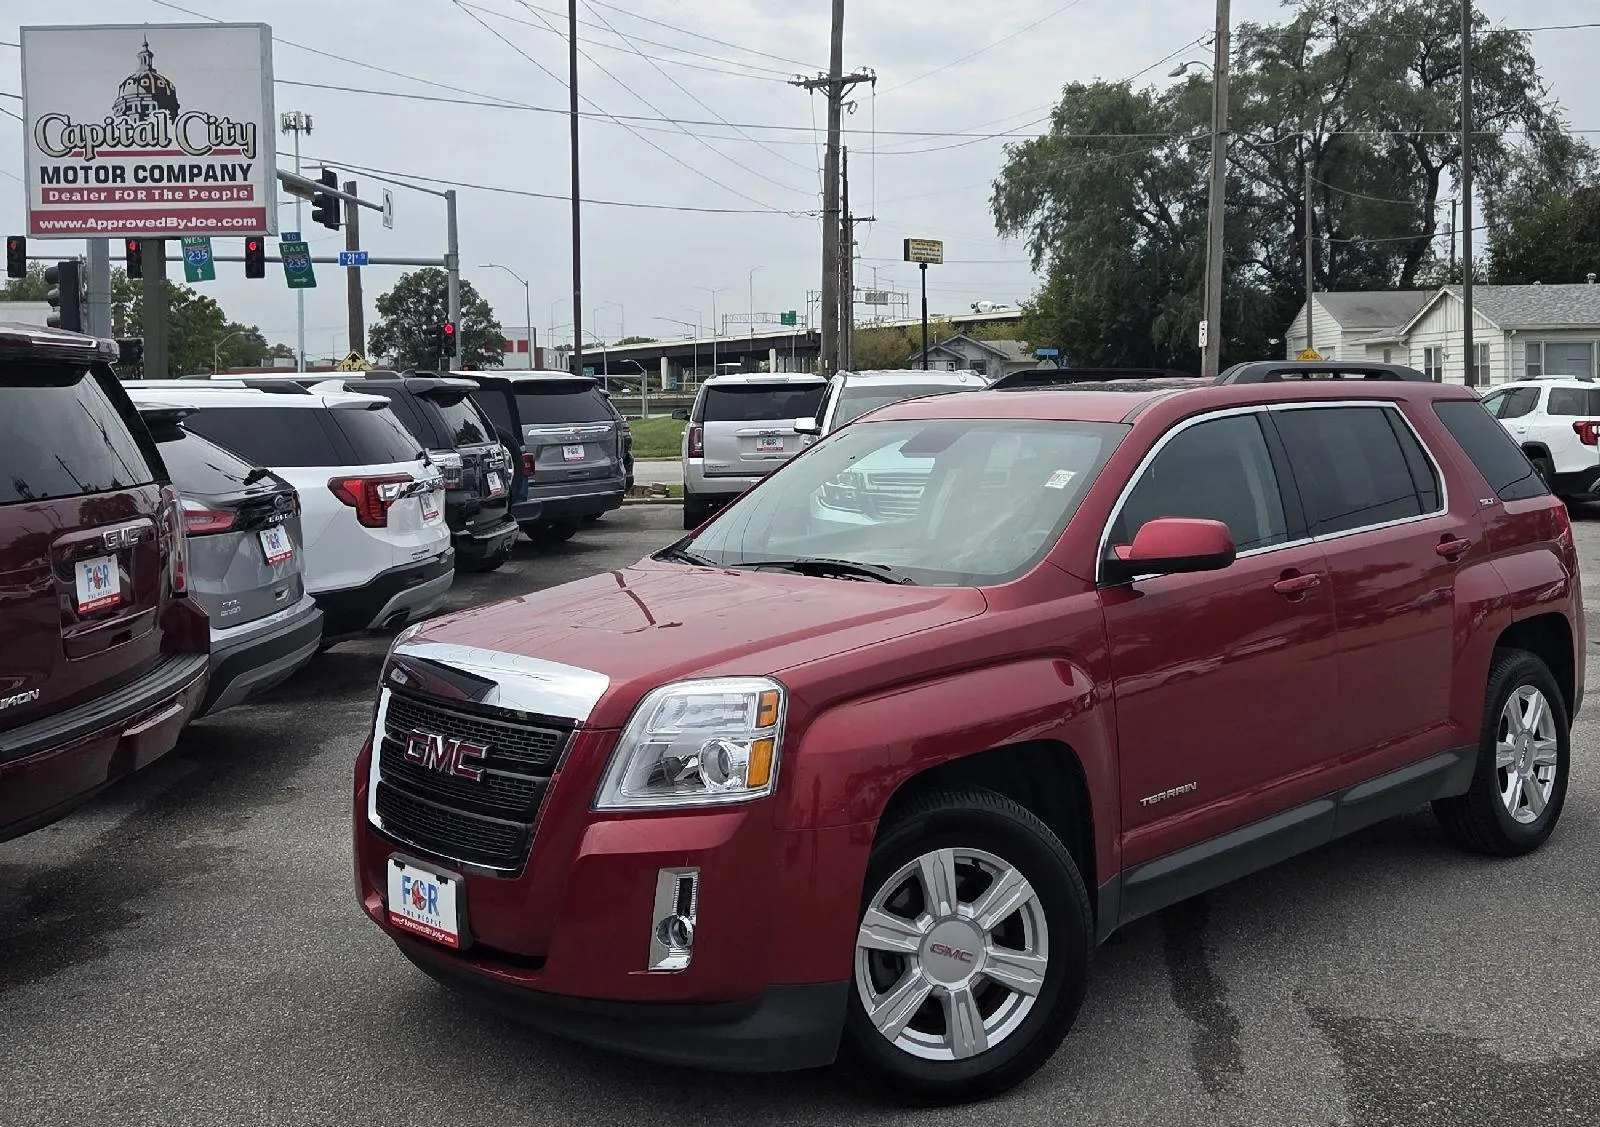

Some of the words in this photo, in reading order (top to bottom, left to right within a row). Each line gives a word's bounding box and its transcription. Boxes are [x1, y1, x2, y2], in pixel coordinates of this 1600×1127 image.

[34, 112, 172, 162] Capital
[175, 111, 257, 159] City
[40, 165, 126, 184] MOTOR
[133, 163, 253, 184] COMPANY
[49, 190, 107, 201] Dealer
[114, 189, 147, 200] FOR
[151, 189, 184, 200] The
[188, 187, 249, 200] People
[39, 215, 257, 231] www.ApprovedByJoe.com
[183, 236, 206, 245] WEST
[283, 244, 305, 253] EAST
[188, 250, 208, 261] 235
[287, 259, 307, 268] 235
[102, 526, 141, 550] GMC
[85, 563, 112, 592] FOR
[404, 729, 490, 782] GMC
[1140, 781, 1197, 807] TERRAIN
[401, 874, 441, 917] FOR
[930, 941, 974, 963] GMC
